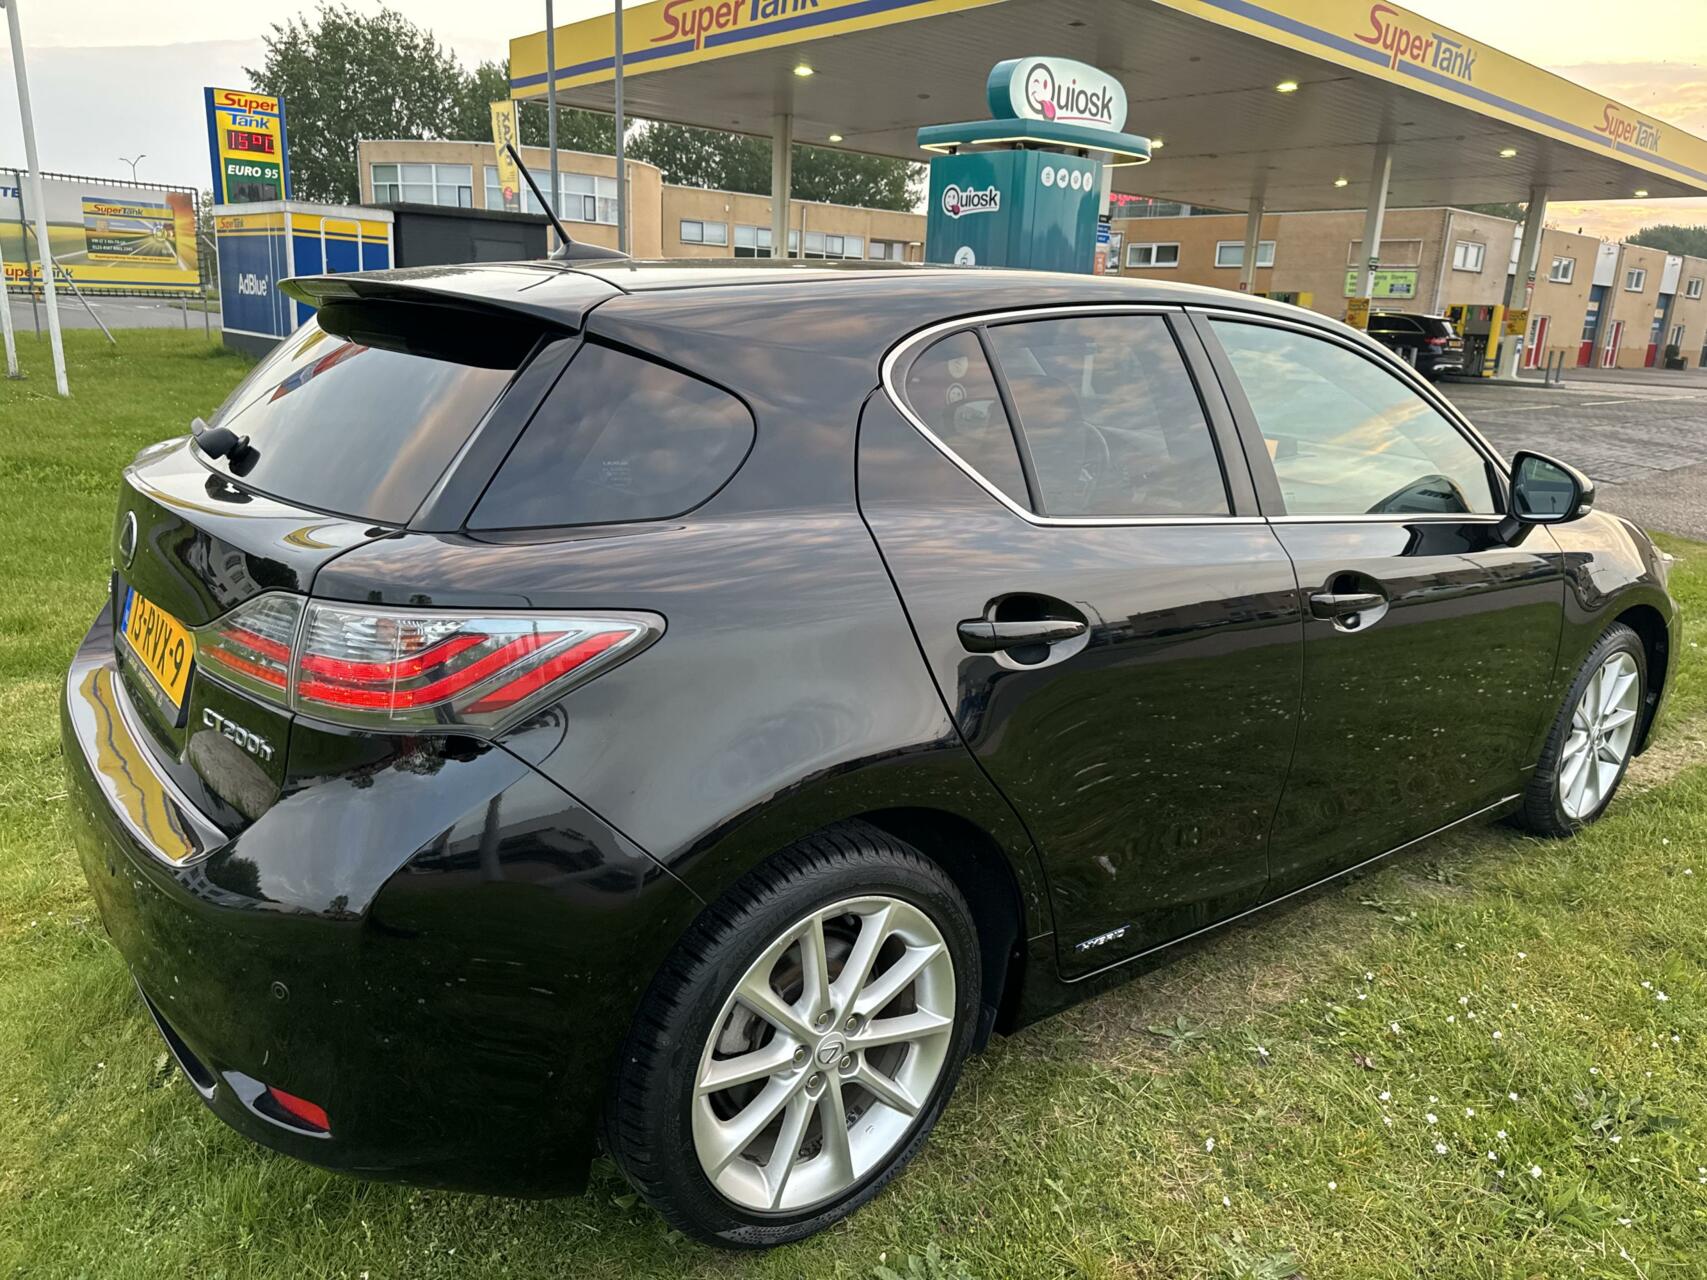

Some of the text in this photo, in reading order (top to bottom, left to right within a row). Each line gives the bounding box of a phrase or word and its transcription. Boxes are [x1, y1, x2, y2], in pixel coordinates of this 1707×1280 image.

[1354, 4, 1476, 81] SuperTank
[216, 92, 278, 114] Super
[1025, 63, 1113, 121] Quiosk
[226, 112, 271, 130] Tank
[1593, 103, 1661, 152] SuperTank
[227, 164, 279, 179] EURO 95
[944, 187, 998, 216] Quiosk
[131, 593, 185, 688] 13-RVX-9
